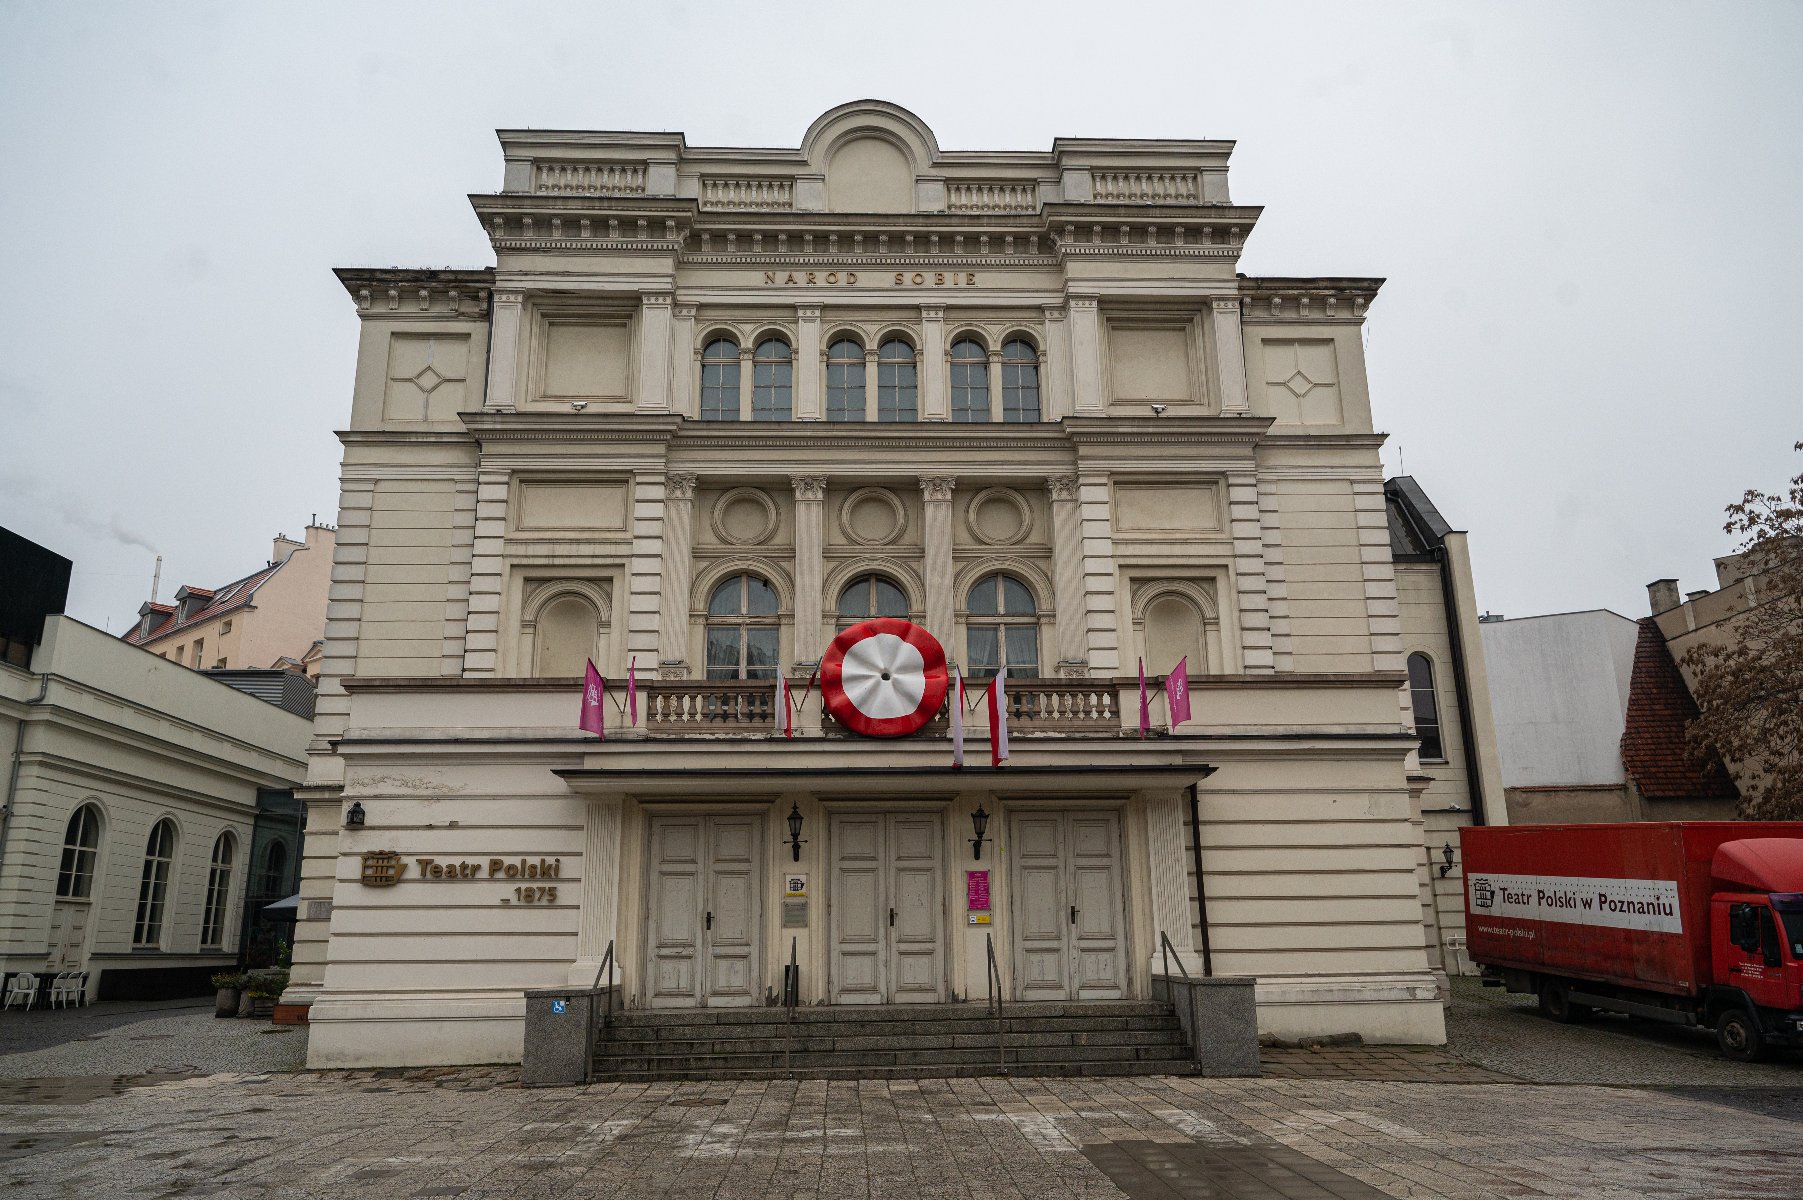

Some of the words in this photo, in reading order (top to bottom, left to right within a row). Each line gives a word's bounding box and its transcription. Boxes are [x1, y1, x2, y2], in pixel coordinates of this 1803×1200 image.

[894, 272, 976, 285] SOBIE
[416, 858, 481, 878] Teatr
[488, 858, 560, 878] Polski
[1499, 887, 1532, 906] Teatr
[1537, 889, 1577, 909] Polski
[1581, 897, 1593, 910] w
[1598, 892, 1674, 917] Poznaniu
